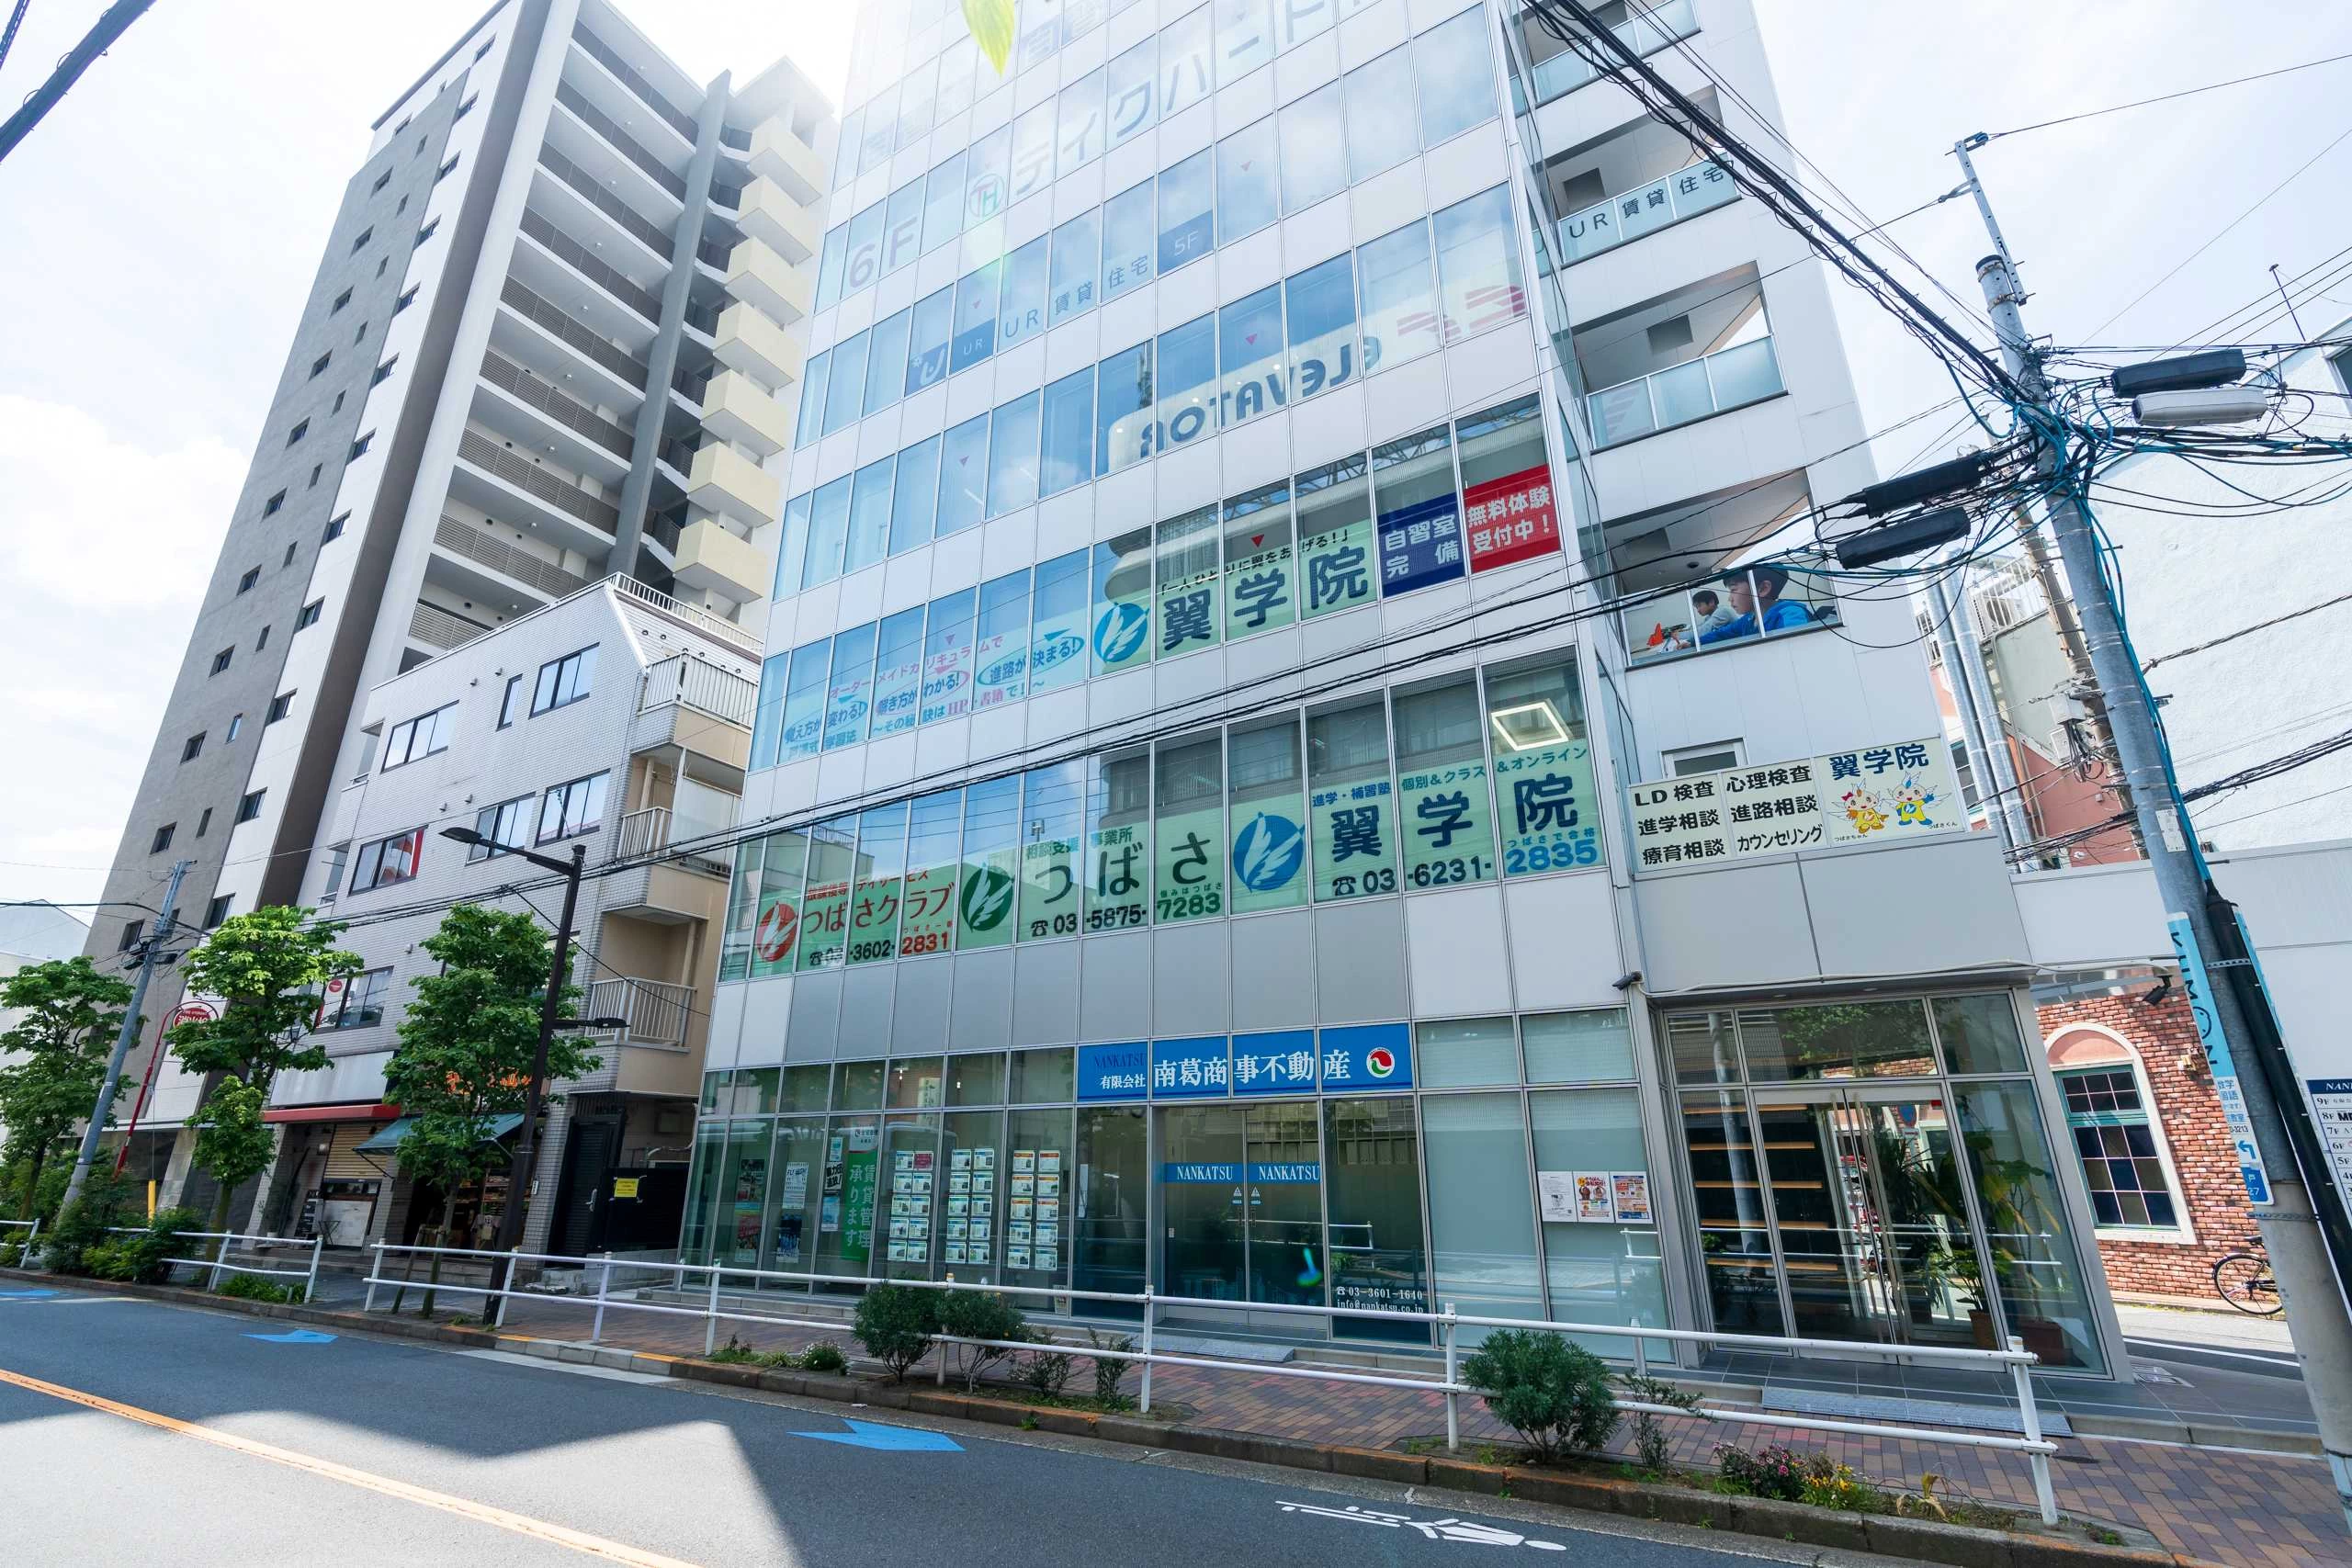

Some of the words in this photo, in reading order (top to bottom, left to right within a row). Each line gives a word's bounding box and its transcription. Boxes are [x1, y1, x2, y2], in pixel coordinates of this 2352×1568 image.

[1568, 165, 1725, 239] UR賃貸住宅
[849, 215, 918, 288] 6F
[1174, 231, 1200, 256] 5F
[963, 338, 984, 355] UR
[1467, 484, 1552, 528] 無料体験
[1384, 514, 1458, 549] 自習室
[1473, 514, 1550, 554] 受付中！
[1385, 543, 1460, 579] 完備
[1162, 546, 1368, 651] 翼学院
[1829, 742, 1930, 781] 翼学院
[1312, 782, 1391, 807] 進学・補習塾
[1726, 766, 1813, 794] 心理検査
[1331, 773, 1578, 863] 翼学院
[1637, 809, 1721, 838] 進学相談
[1730, 795, 1818, 824] 進路相談
[1507, 828, 1596, 850] つばさで合格
[1642, 837, 1725, 865] 療育相談
[1736, 823, 1824, 853] カウンセリング
[1035, 832, 1211, 904] つばさ
[804, 882, 955, 934] つばさクラブ
[1100, 1073, 1147, 1089] 有限会社
[1154, 1049, 1351, 1089] 南葛商事不動産
[2316, 1097, 2329, 1105] 9F
[2323, 1111, 2335, 1120] 8F
[2326, 1126, 2339, 1134] 7F
[1176, 1166, 1233, 1180] NANKATSU
[1259, 1165, 1320, 1180] NANKATSU
[2337, 1156, 2350, 1165] 5F
[844, 1164, 864, 1247] 承ります
